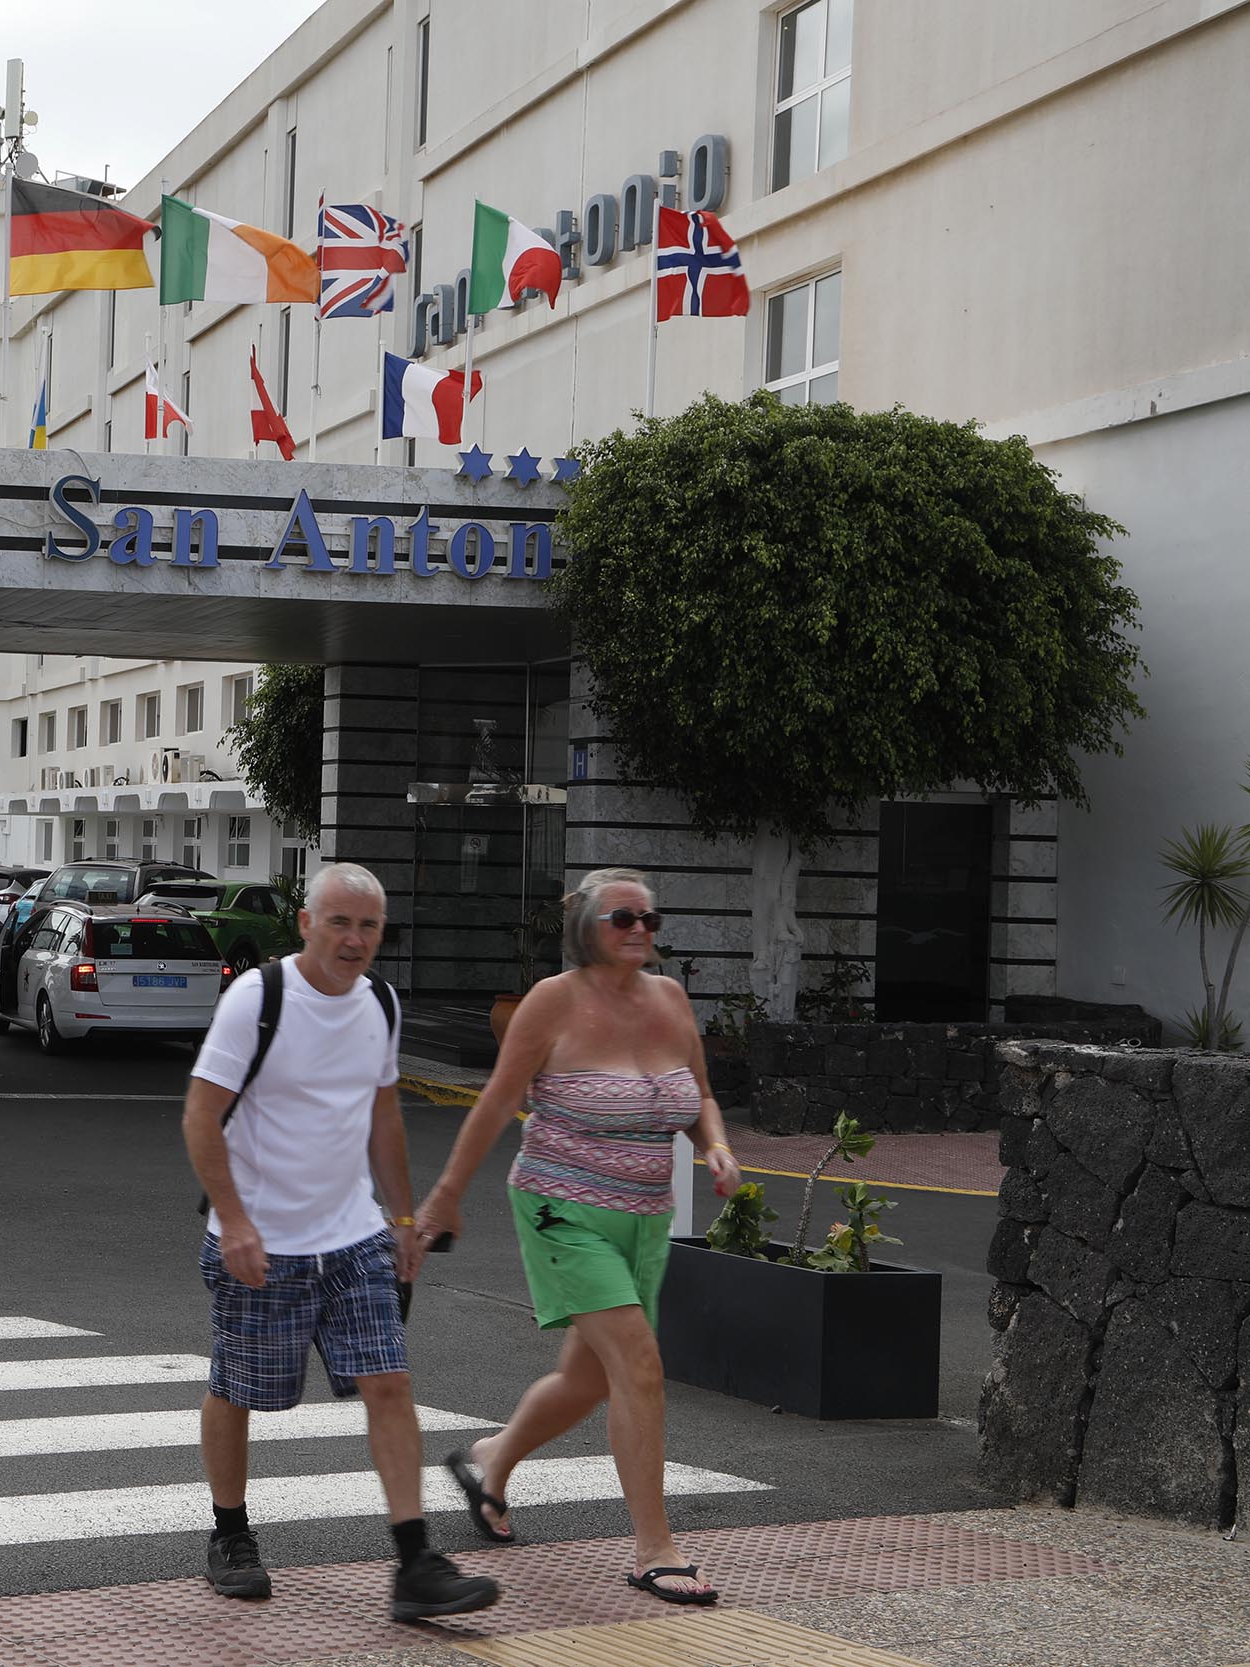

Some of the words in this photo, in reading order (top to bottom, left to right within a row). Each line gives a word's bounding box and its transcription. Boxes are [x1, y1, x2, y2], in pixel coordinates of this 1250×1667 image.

[497, 133, 728, 310] tonio
[46, 474, 221, 568] San
[576, 752, 585, 777] H
[139, 976, 165, 986] 5186
[167, 977, 186, 987] JVP
